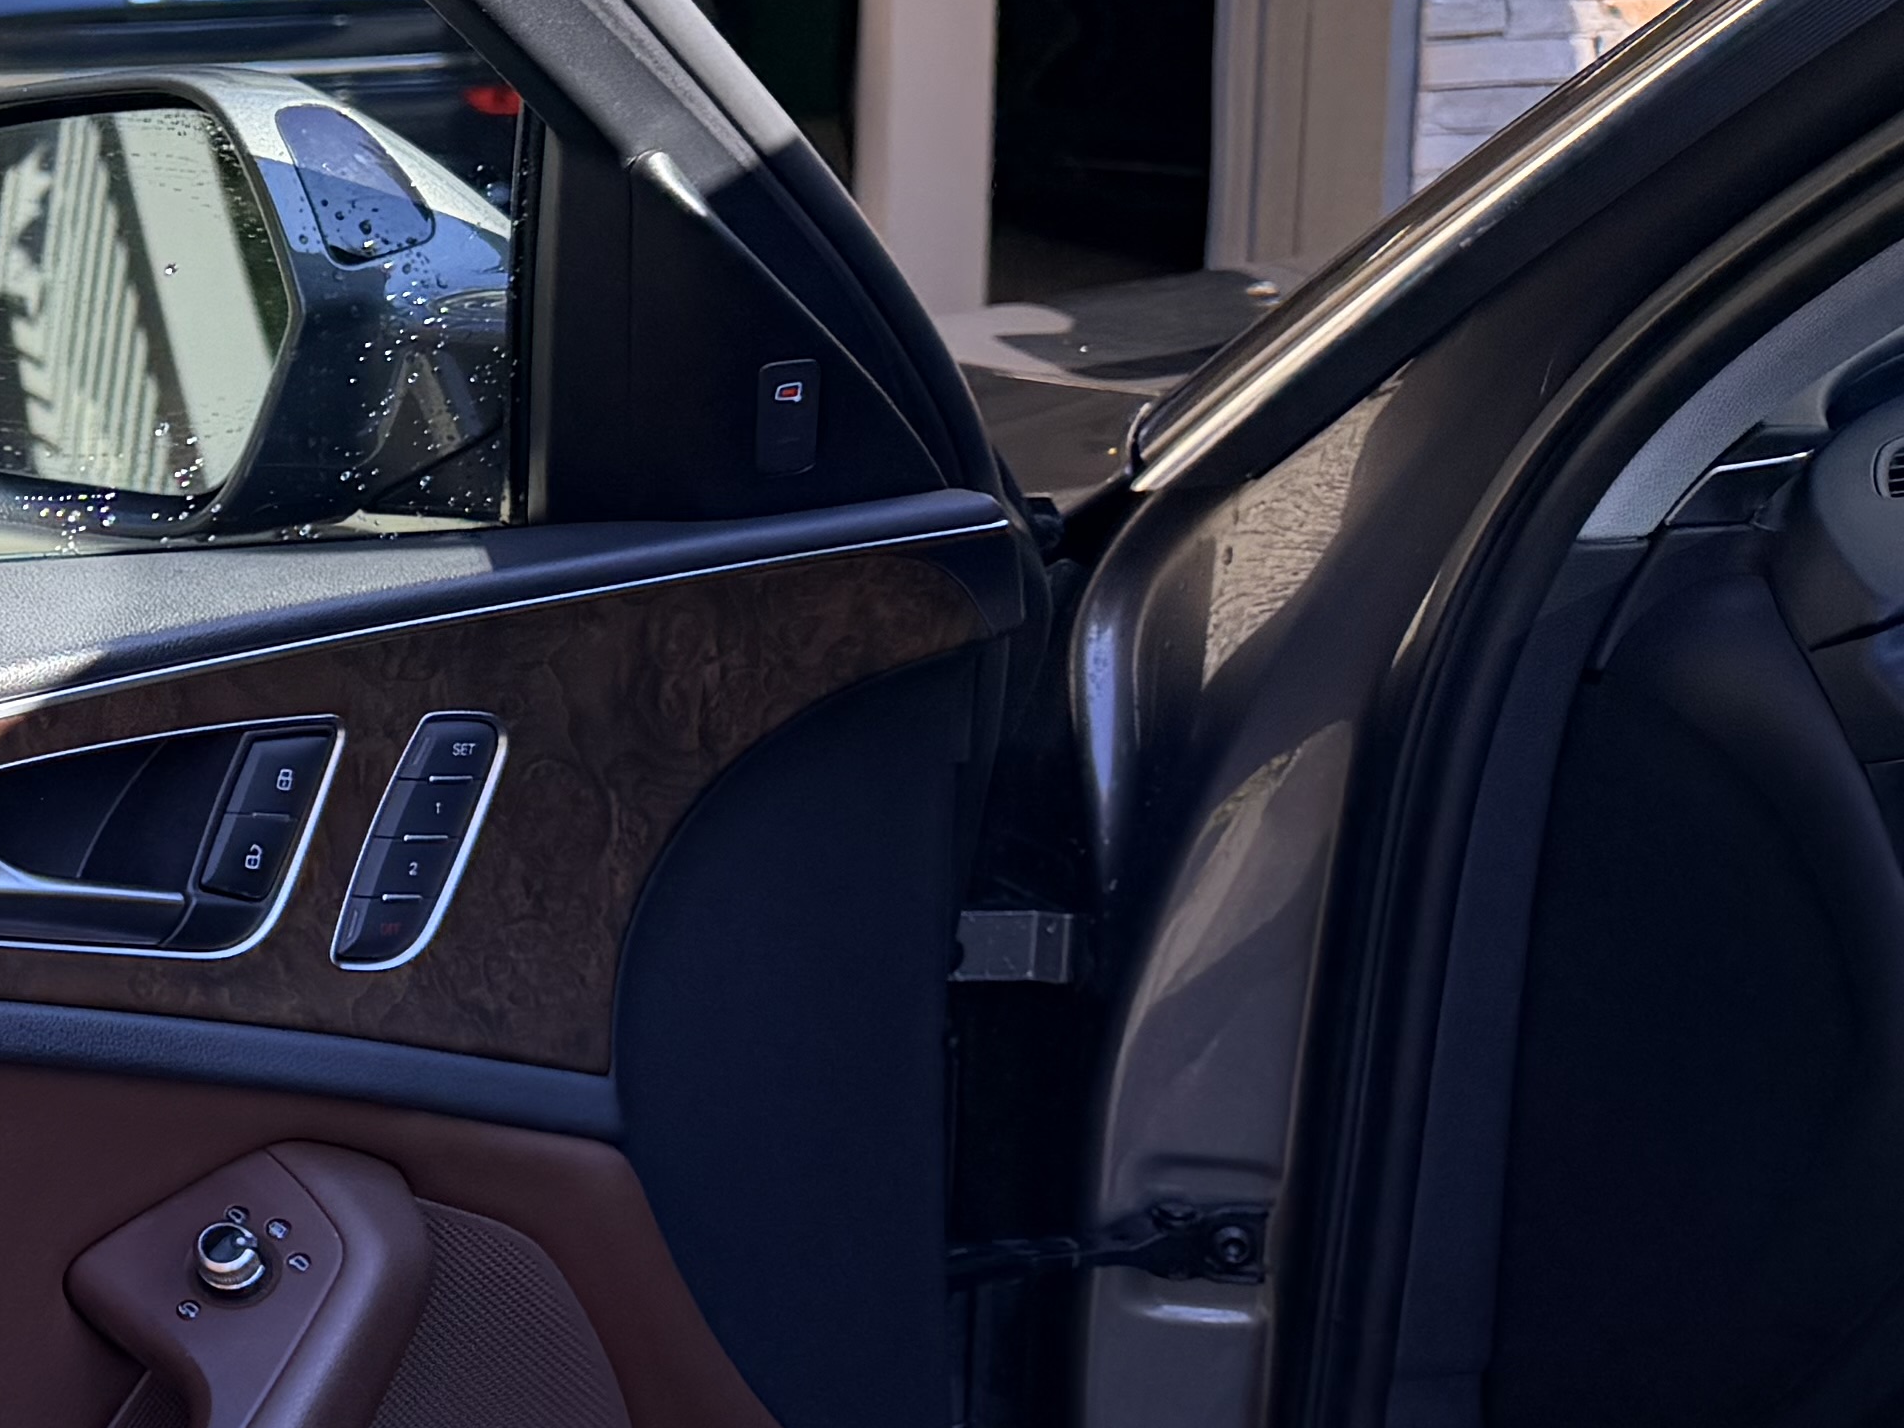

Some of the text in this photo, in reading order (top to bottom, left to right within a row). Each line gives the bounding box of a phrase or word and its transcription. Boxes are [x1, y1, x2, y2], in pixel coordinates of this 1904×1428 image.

[452, 742, 476, 756] SET
[435, 802, 441, 814] 1
[408, 861, 418, 876] 2
